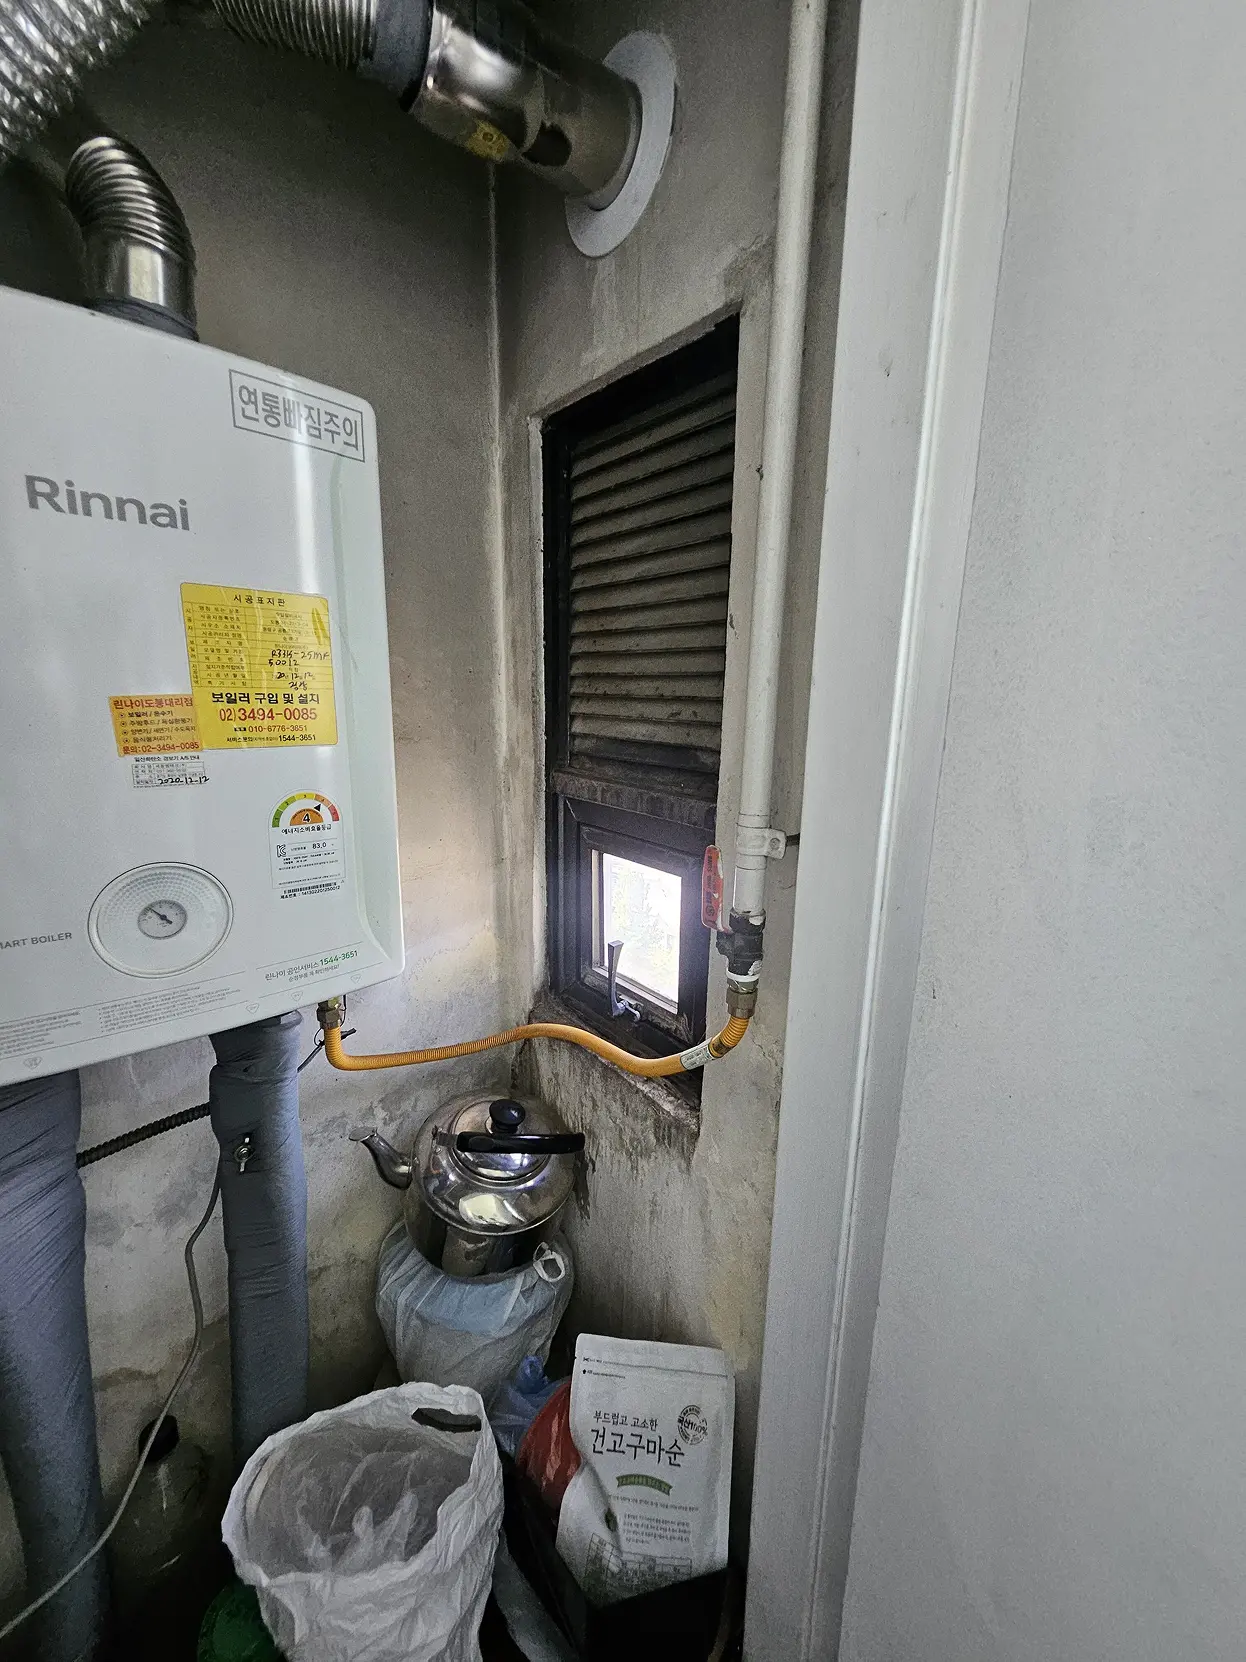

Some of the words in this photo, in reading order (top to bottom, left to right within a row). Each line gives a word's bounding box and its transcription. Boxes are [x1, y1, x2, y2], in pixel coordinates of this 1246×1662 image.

[238, 384, 359, 451] 연통빠짐주의
[24, 474, 190, 531] Rinnai
[234, 594, 286, 607] 시공표지판
[212, 692, 250, 704] 보일러
[283, 692, 294, 704] 및
[158, 775, 210, 784] 2020-12-12
[303, 813, 310, 822] 4
[281, 824, 332, 834] 에너지소비효율등급
[30, 932, 72, 944] BOILER
[264, 970, 286, 981] 린나이
[320, 950, 358, 966] 1544-3651
[593, 1410, 628, 1426] 부드럽고
[630, 1416, 658, 1432] 고소한
[591, 1426, 685, 1468] 건고구마순
